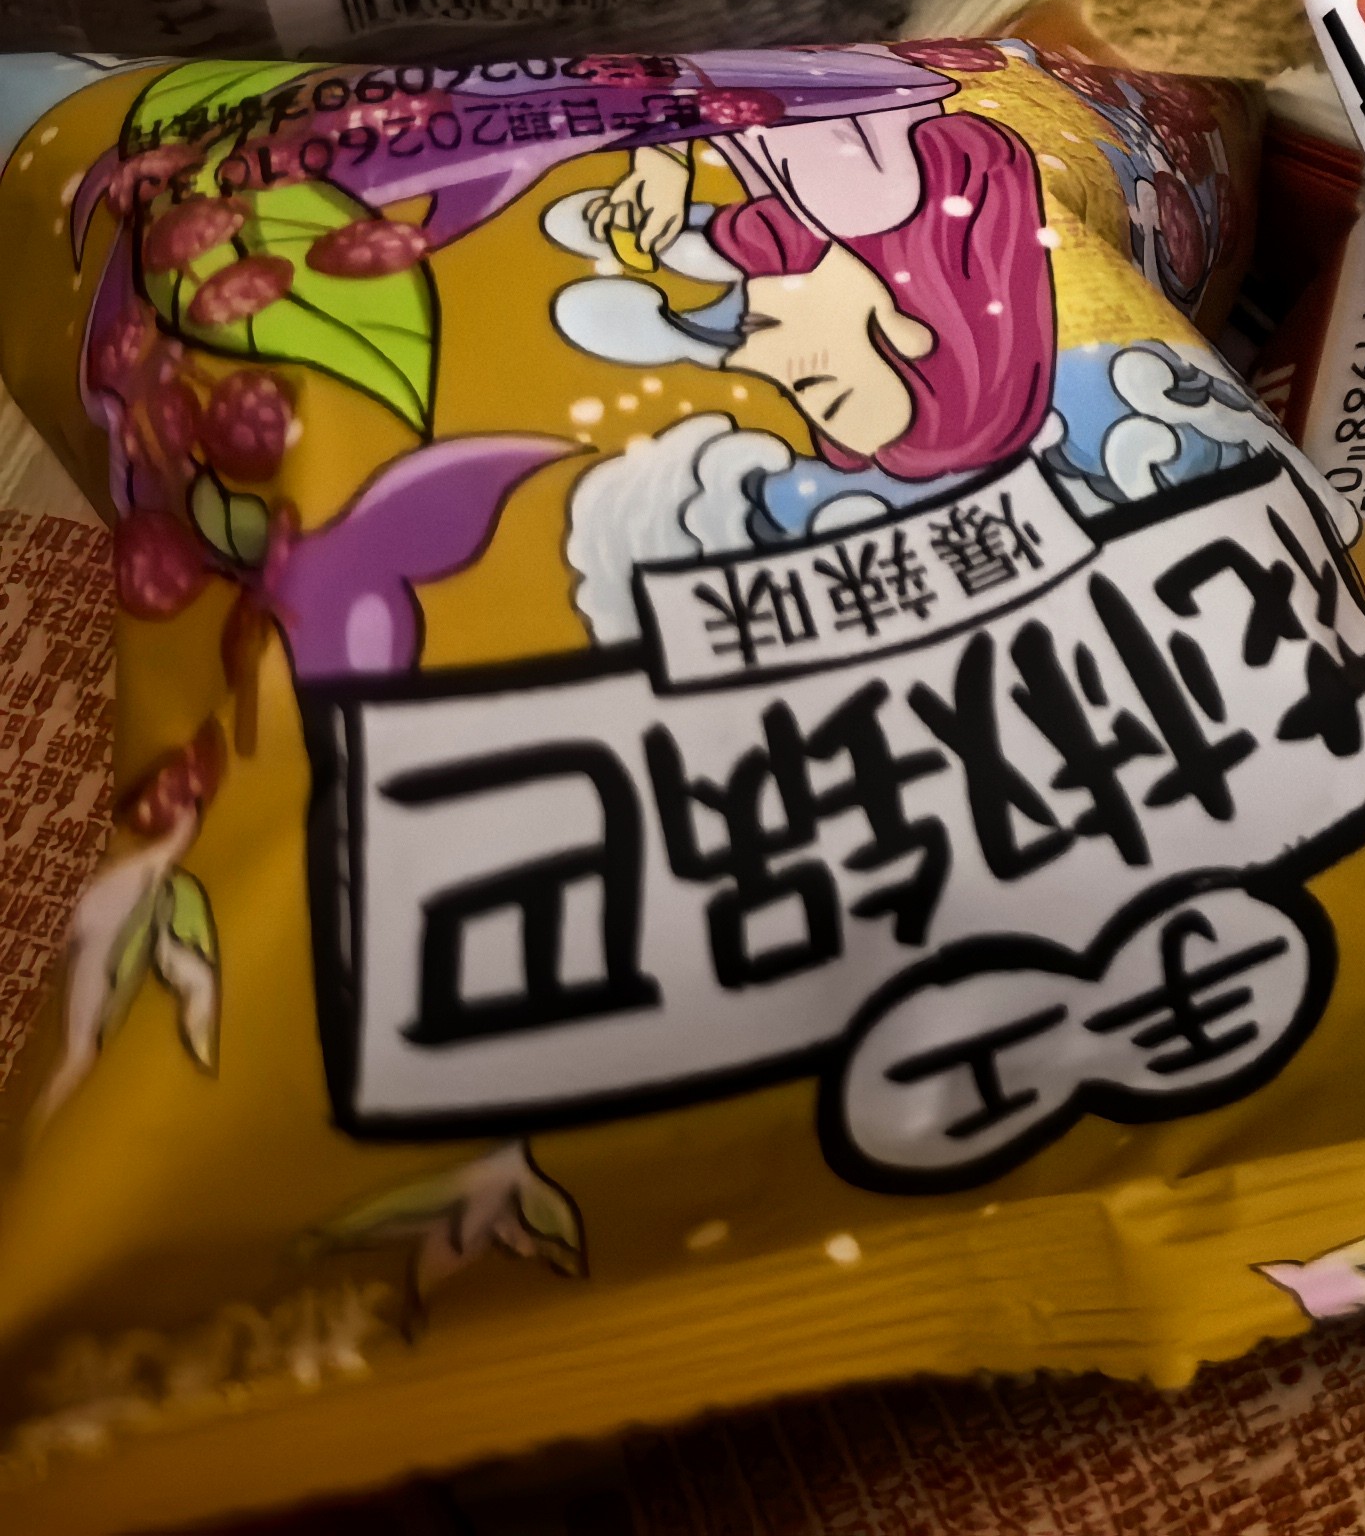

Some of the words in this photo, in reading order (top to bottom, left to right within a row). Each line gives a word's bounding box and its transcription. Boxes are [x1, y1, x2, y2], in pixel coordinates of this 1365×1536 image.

[701, 485, 1062, 660] 爆辣味
[884, 908, 1289, 1138] 手工
